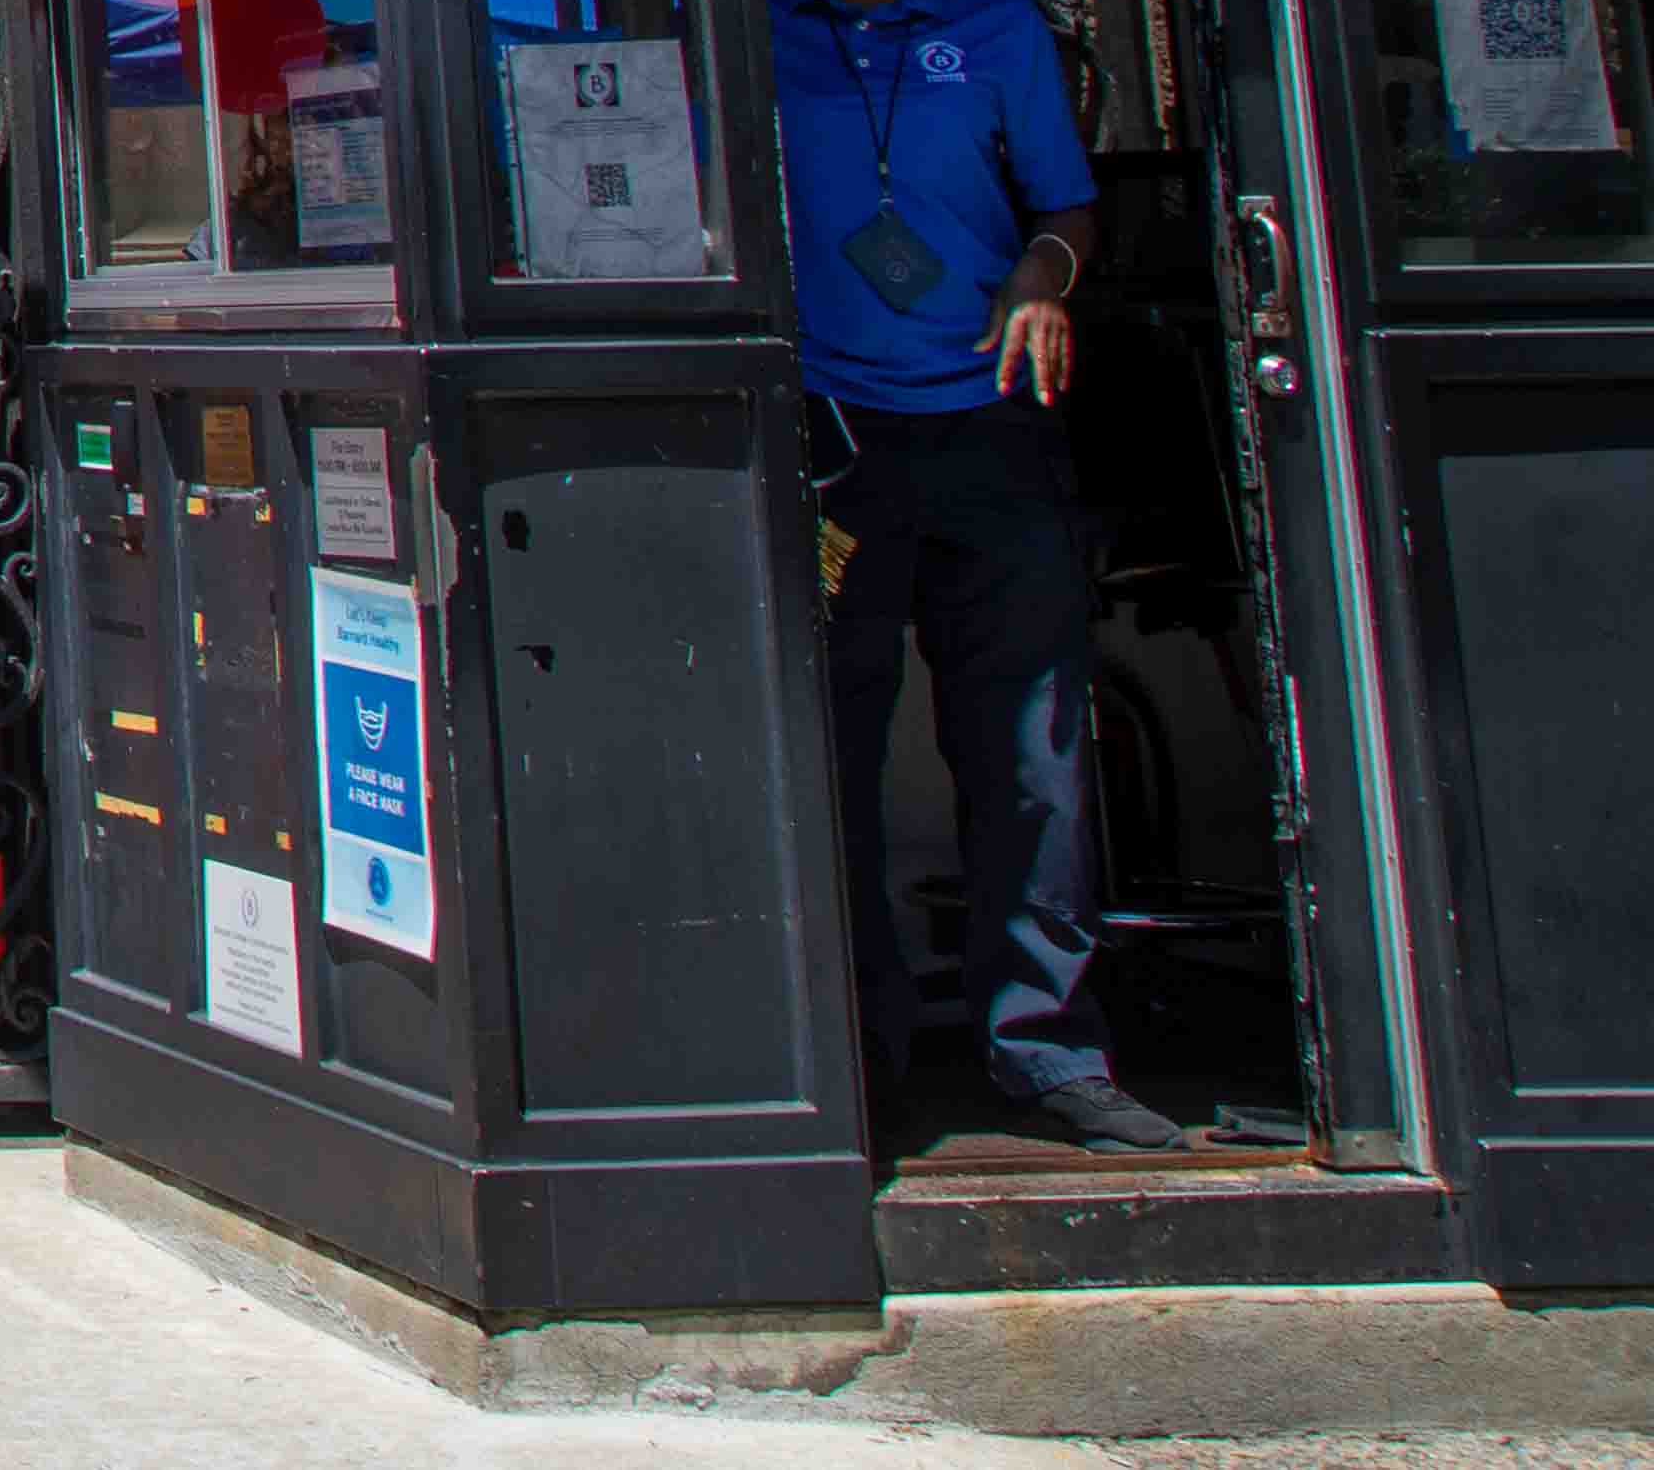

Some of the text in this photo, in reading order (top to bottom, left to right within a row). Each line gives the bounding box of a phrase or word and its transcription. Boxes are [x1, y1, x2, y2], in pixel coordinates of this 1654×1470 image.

[346, 762, 405, 793] PLEASE WEAR
[356, 788, 379, 809] FACE
[380, 794, 406, 818] MASK
